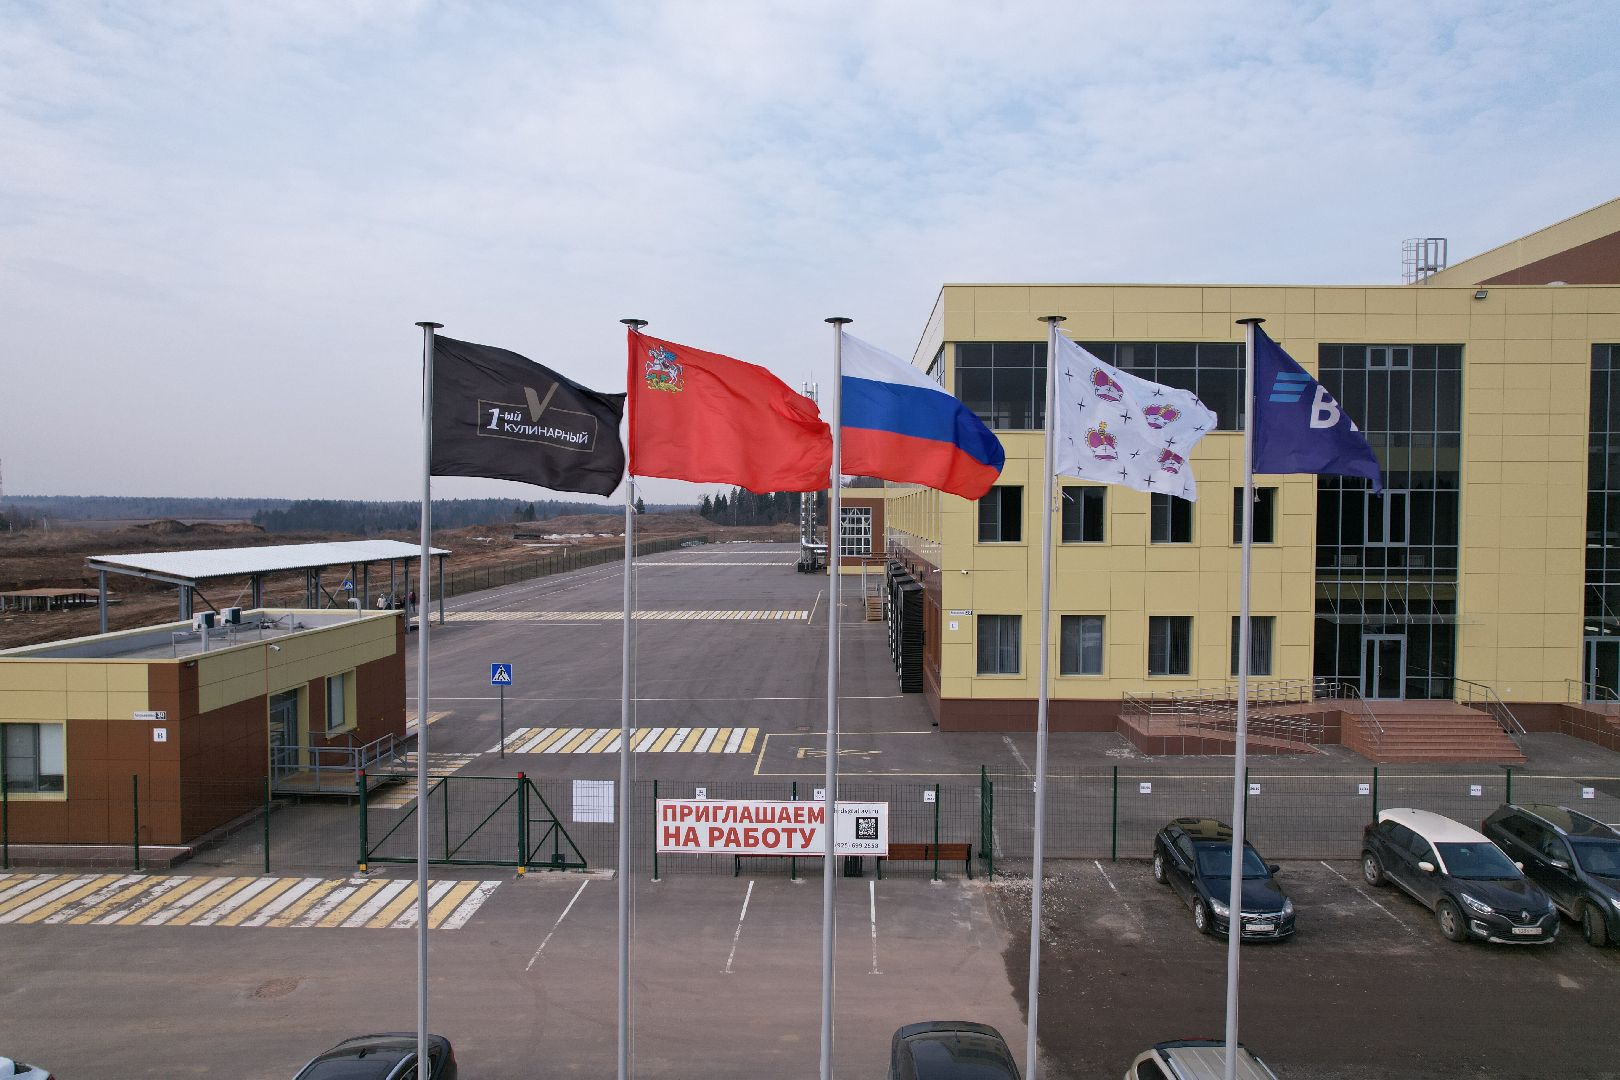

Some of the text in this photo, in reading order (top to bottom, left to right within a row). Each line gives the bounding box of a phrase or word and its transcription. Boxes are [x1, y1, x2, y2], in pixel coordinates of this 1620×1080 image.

[504, 422, 589, 444] КУЛИНАРНЫЙ
[662, 804, 825, 825] ПРИГЛАШАЕМ
[663, 826, 817, 849] НА РАБОТУ
